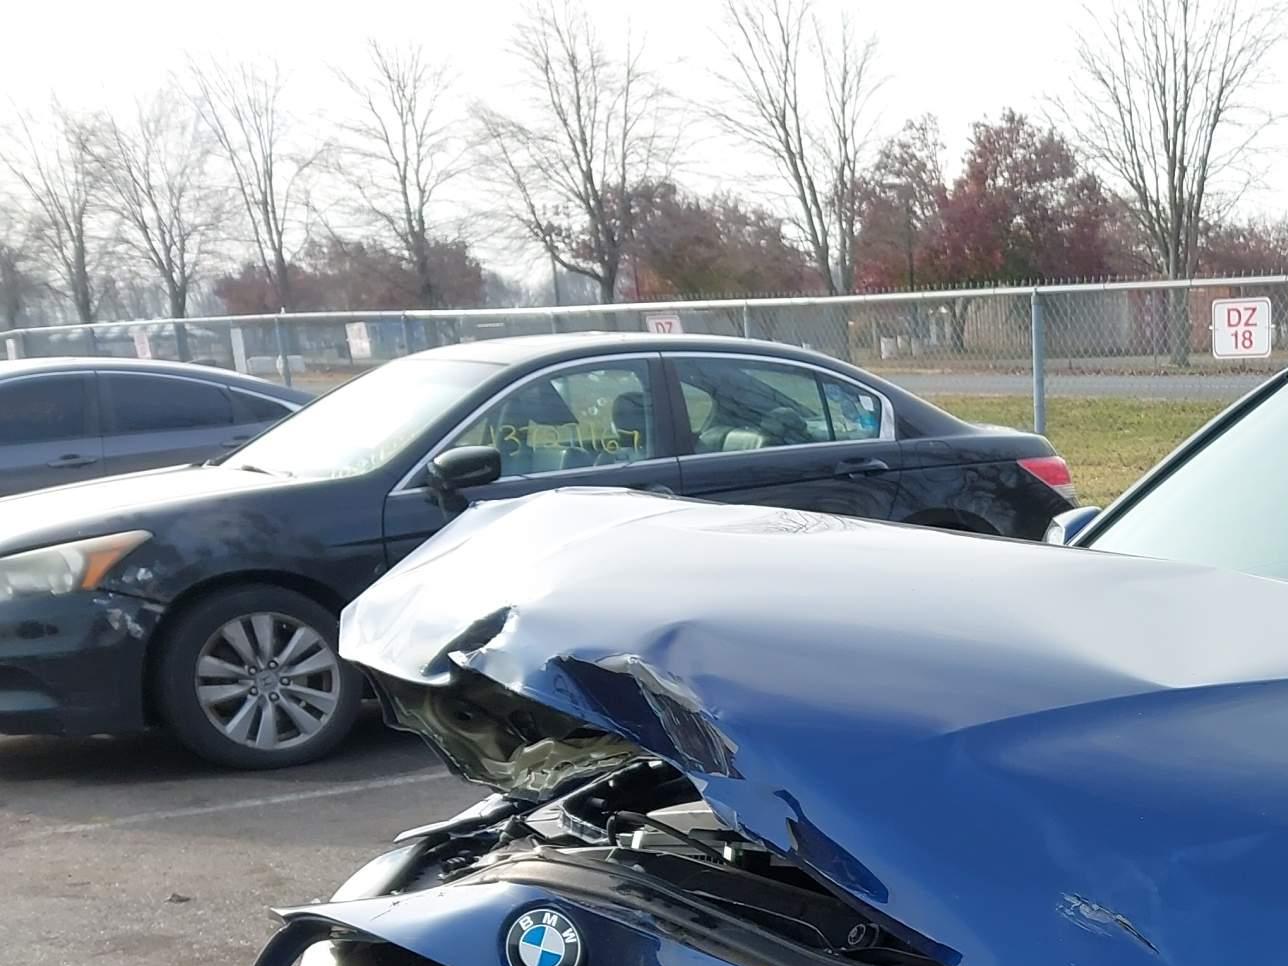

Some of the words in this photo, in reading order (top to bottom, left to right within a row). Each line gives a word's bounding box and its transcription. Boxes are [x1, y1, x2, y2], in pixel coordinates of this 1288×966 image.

[1227, 307, 1257, 327] DZ
[1231, 330, 1253, 349] 18
[519, 912, 577, 943] BMW
